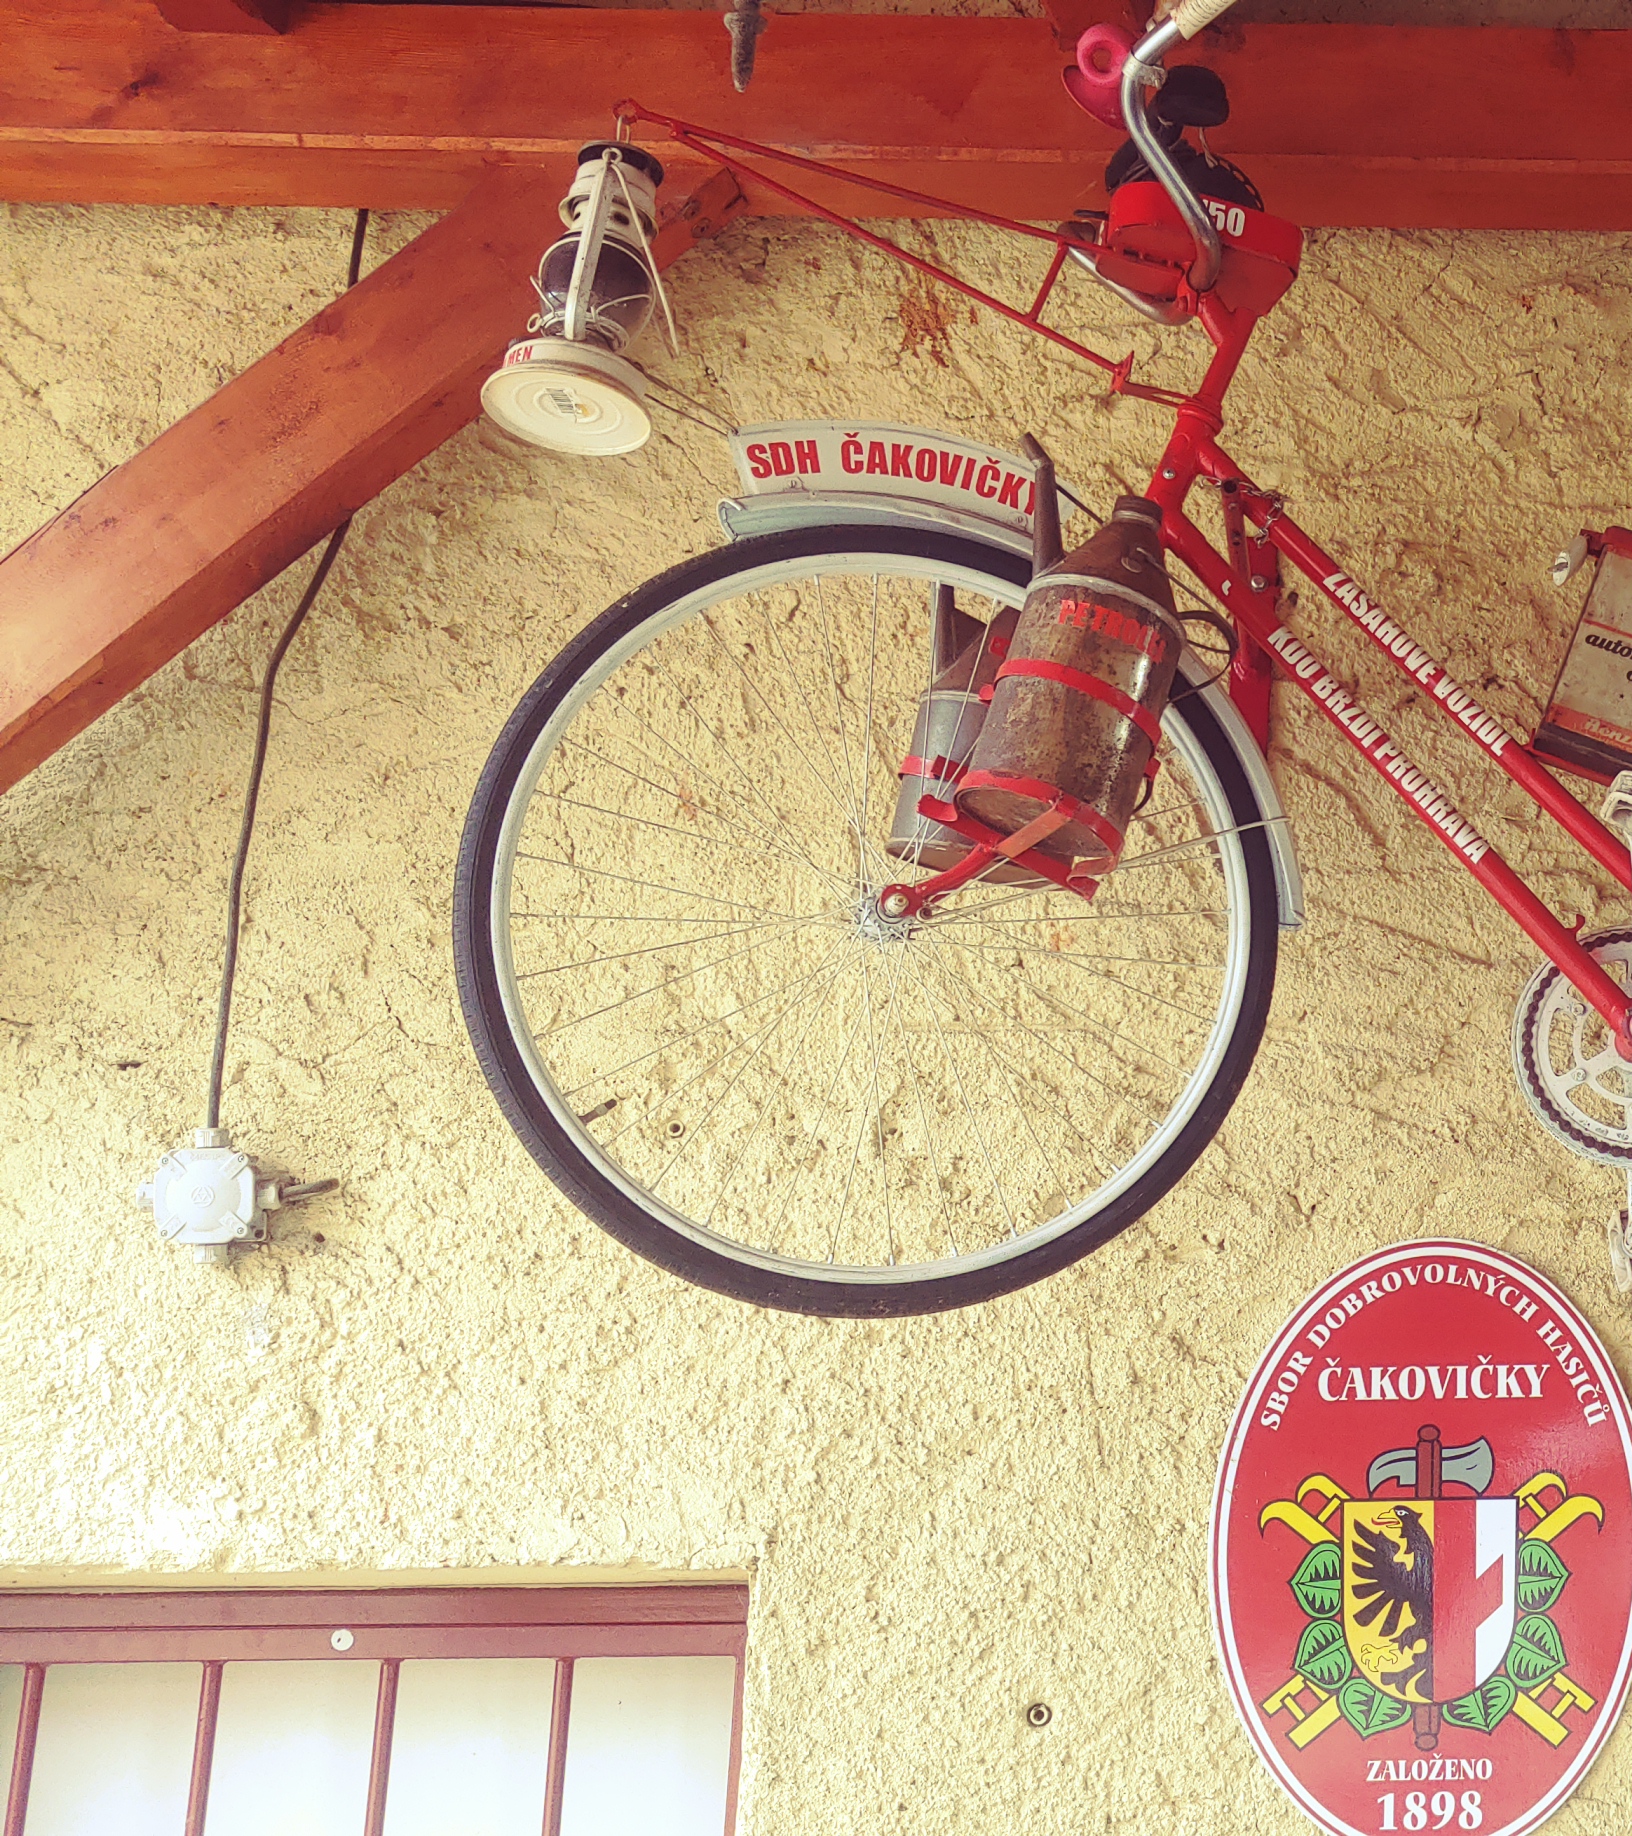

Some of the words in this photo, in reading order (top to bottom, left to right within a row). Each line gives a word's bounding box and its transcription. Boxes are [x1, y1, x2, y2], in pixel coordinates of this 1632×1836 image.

[1203, 199, 1245, 237] 50
[746, 440, 820, 479] SDH
[1260, 1350, 1314, 1431] SBOR
[1306, 1263, 1539, 1350] DOBROVOLNÝCH
[1536, 1319, 1610, 1427] HASIČŮ
[1318, 1355, 1550, 1402] ČAKOVIČKY
[1366, 1753, 1493, 1782] ZALOŽENO
[1377, 1790, 1483, 1831] 1898
